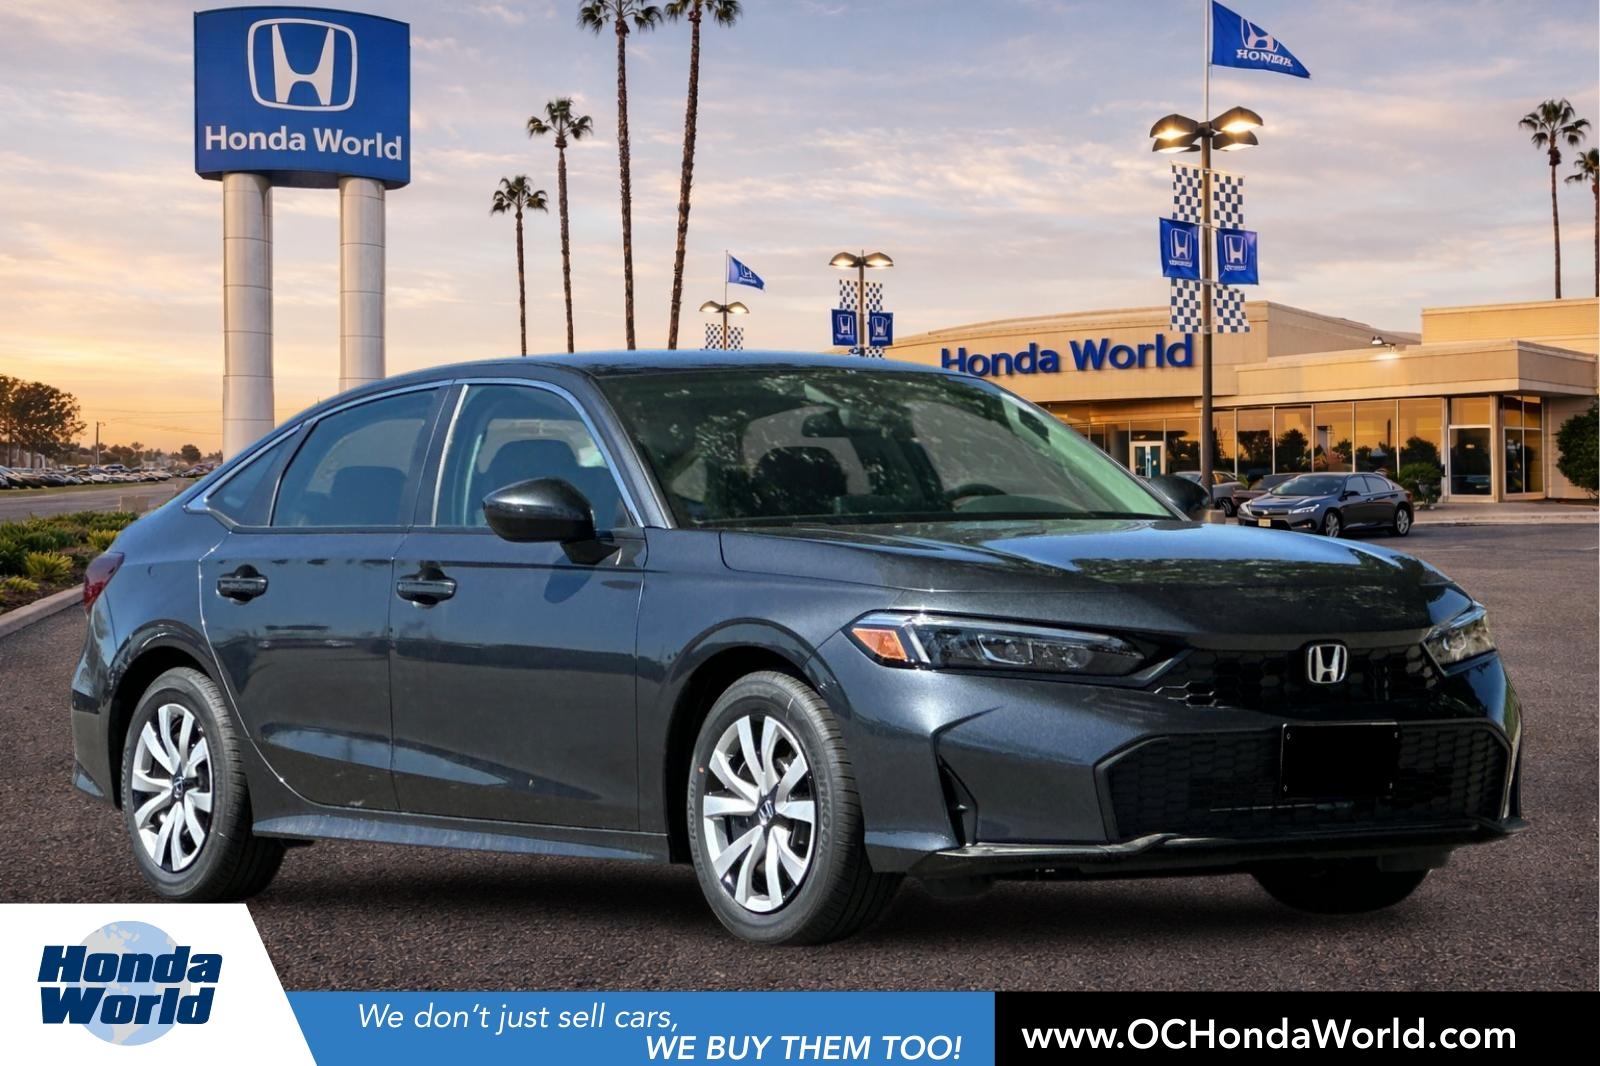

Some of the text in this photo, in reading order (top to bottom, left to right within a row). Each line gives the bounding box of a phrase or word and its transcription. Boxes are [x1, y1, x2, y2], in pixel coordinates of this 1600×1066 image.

[205, 125, 402, 161] Honda World
[940, 333, 1194, 377] Honda World
